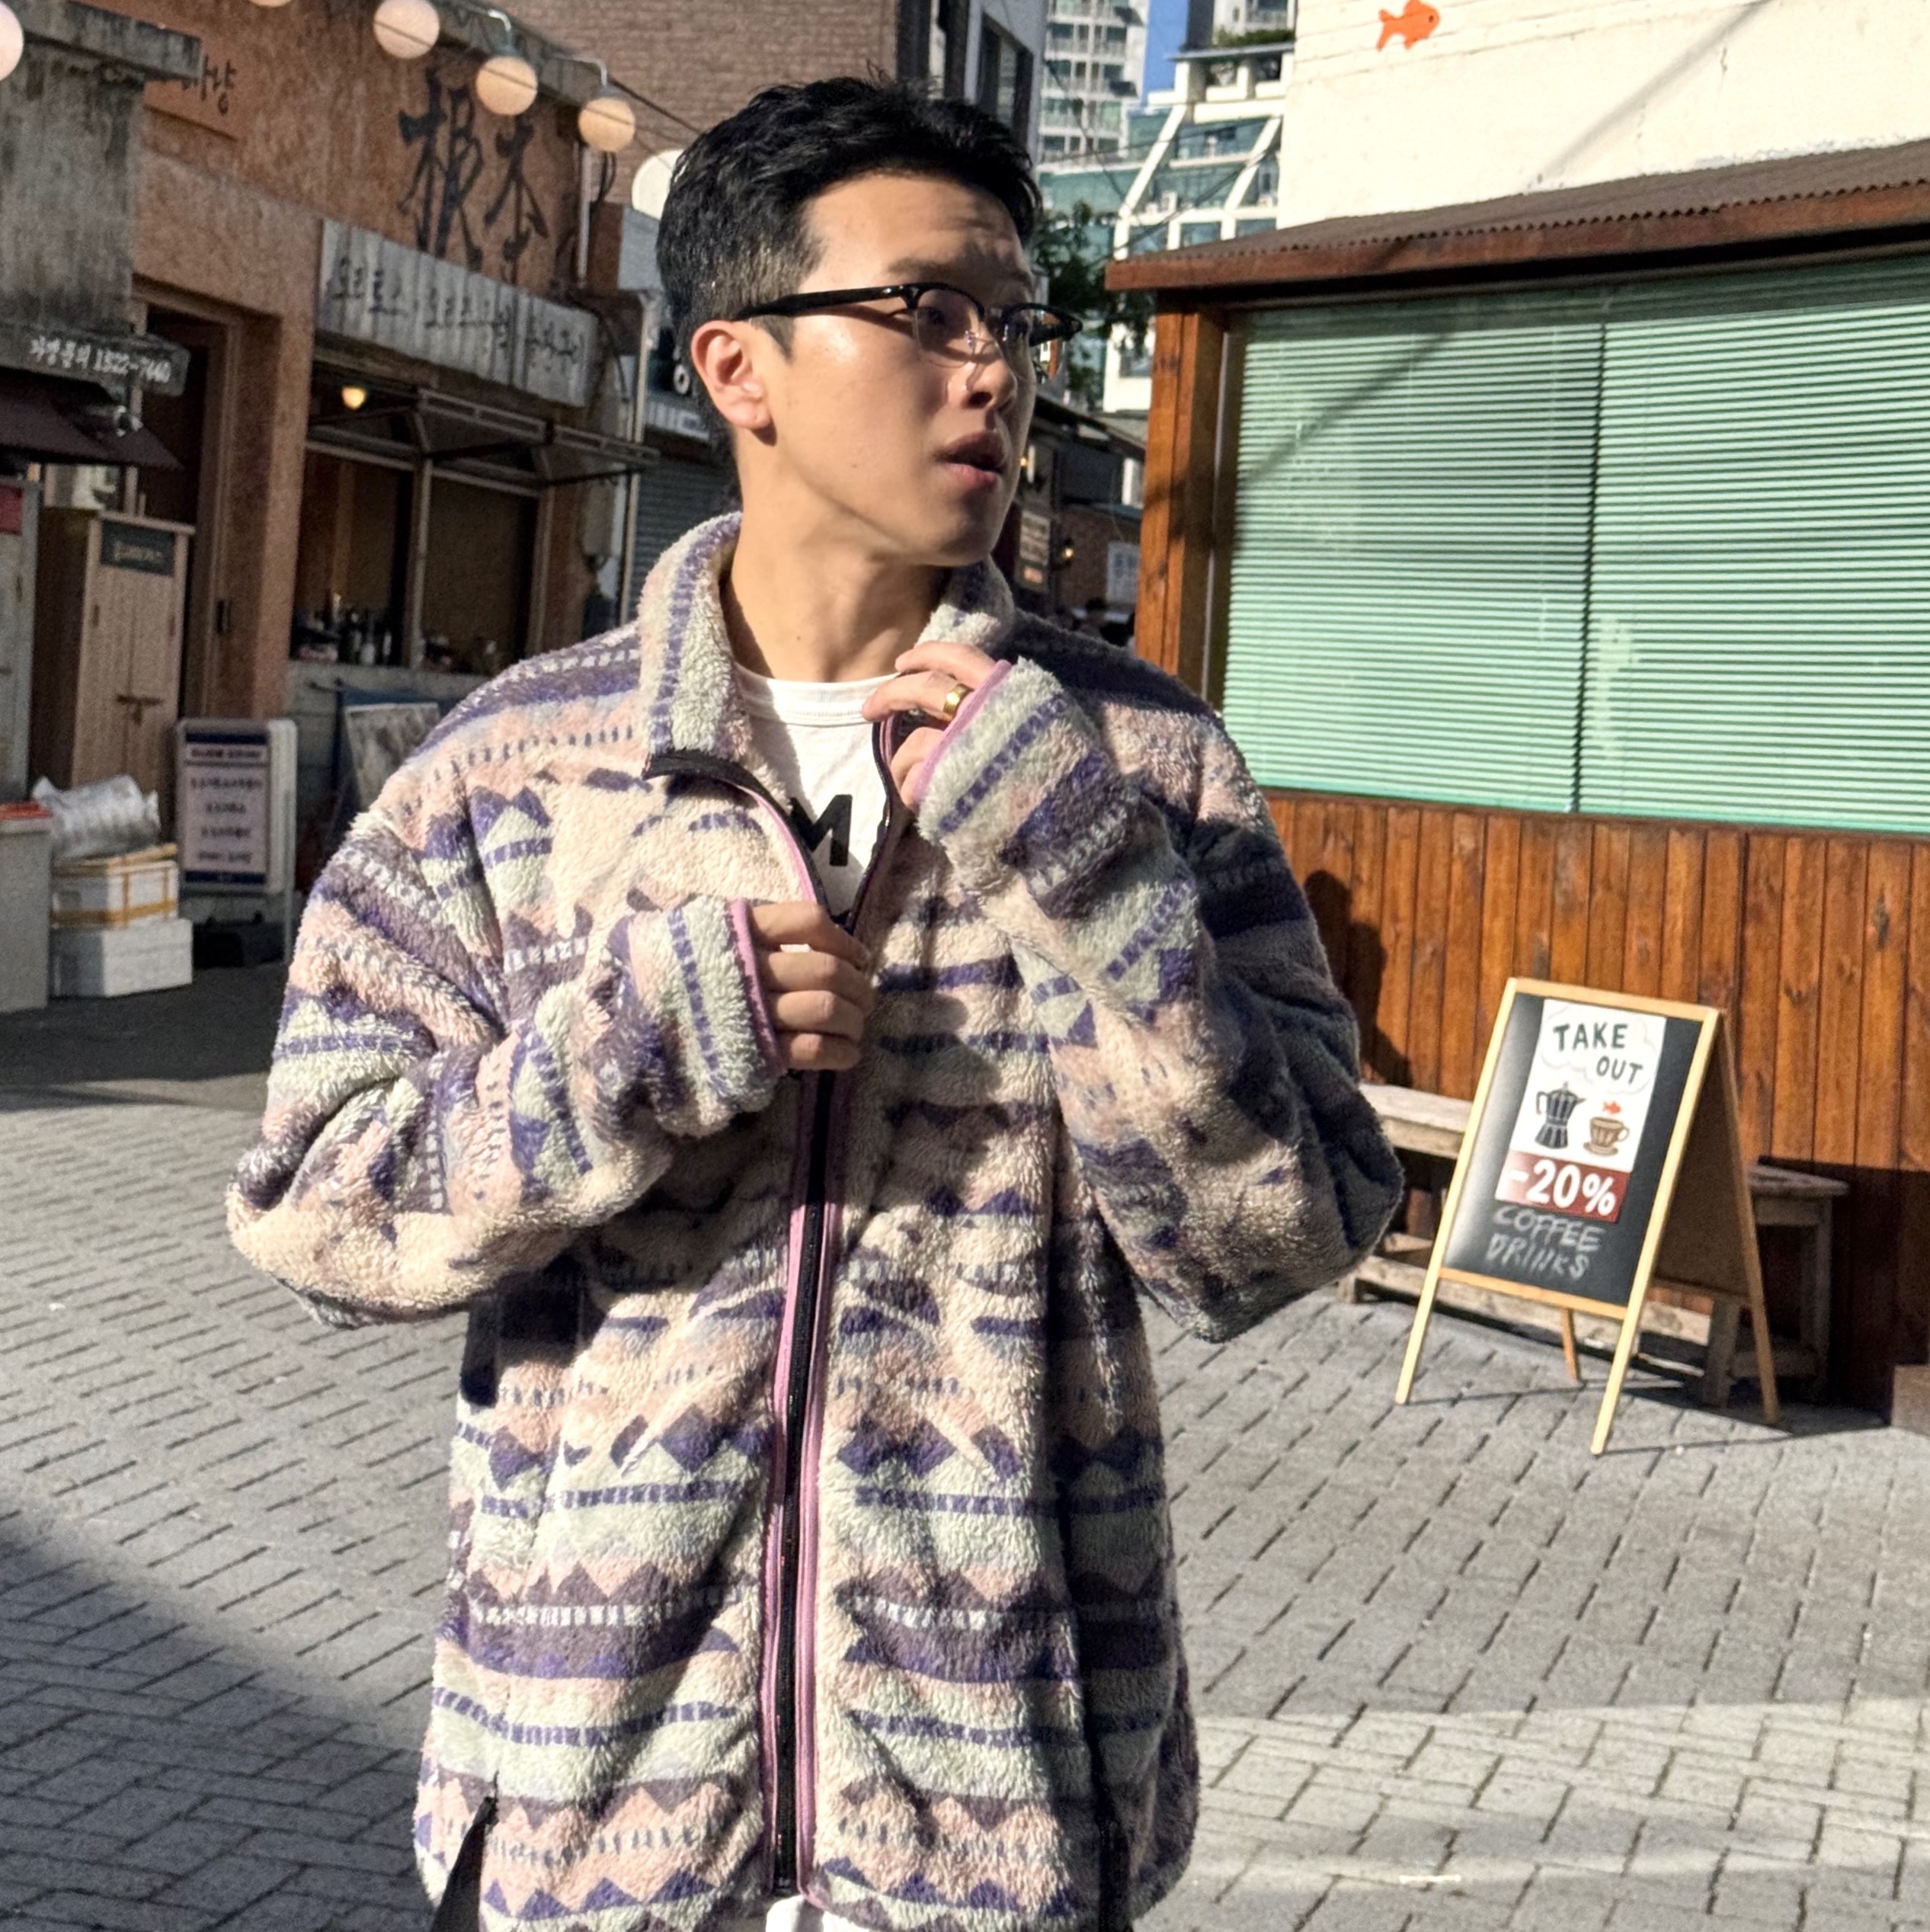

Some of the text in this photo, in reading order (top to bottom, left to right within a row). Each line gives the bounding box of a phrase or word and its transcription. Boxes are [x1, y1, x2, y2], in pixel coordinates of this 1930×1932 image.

[1553, 1023, 1628, 1051] TAKE
[1596, 1056, 1644, 1085] OUT
[1509, 1158, 1617, 1216] -20%
[1494, 1205, 1605, 1252] COFFEE
[1488, 1232, 1591, 1280] DRINKS
